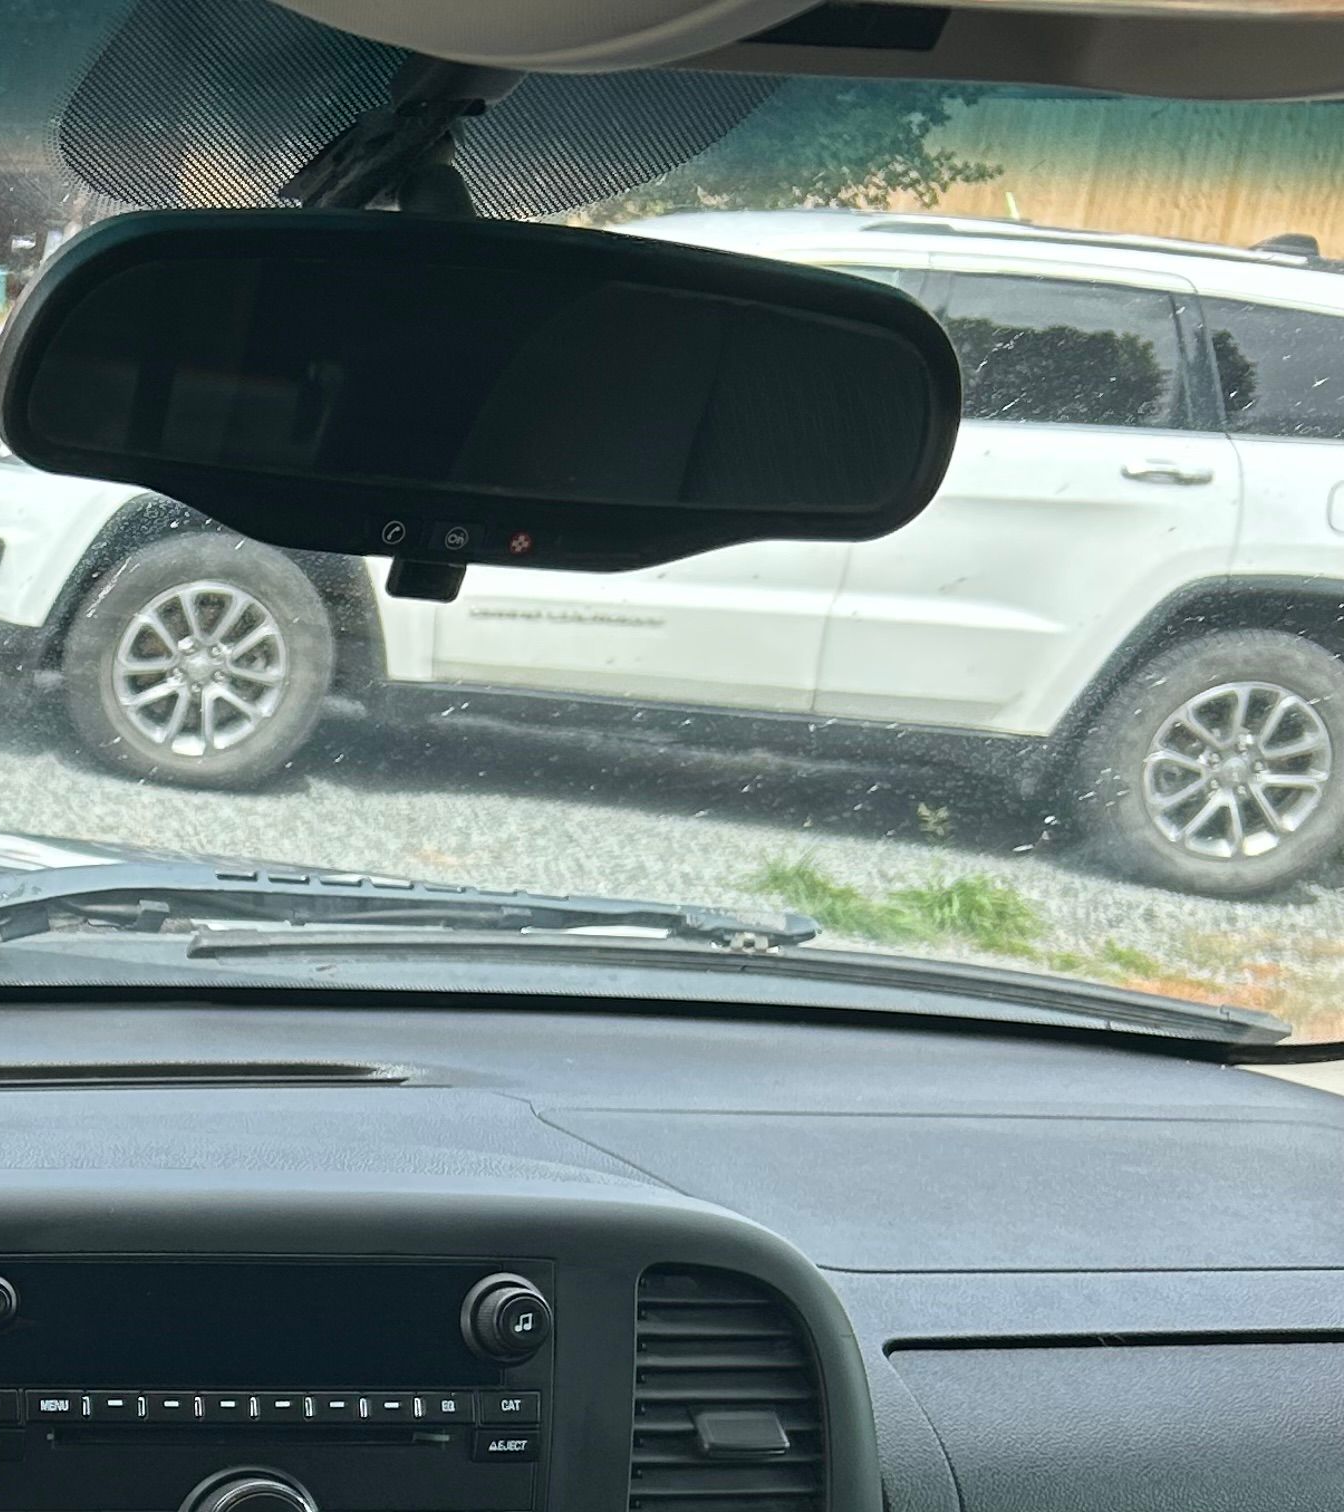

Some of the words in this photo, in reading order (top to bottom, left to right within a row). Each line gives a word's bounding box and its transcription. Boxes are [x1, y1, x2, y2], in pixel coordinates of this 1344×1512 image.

[40, 1399, 70, 1412] MENU
[500, 1399, 522, 1412] CAT
[498, 1440, 528, 1451] EJECT
